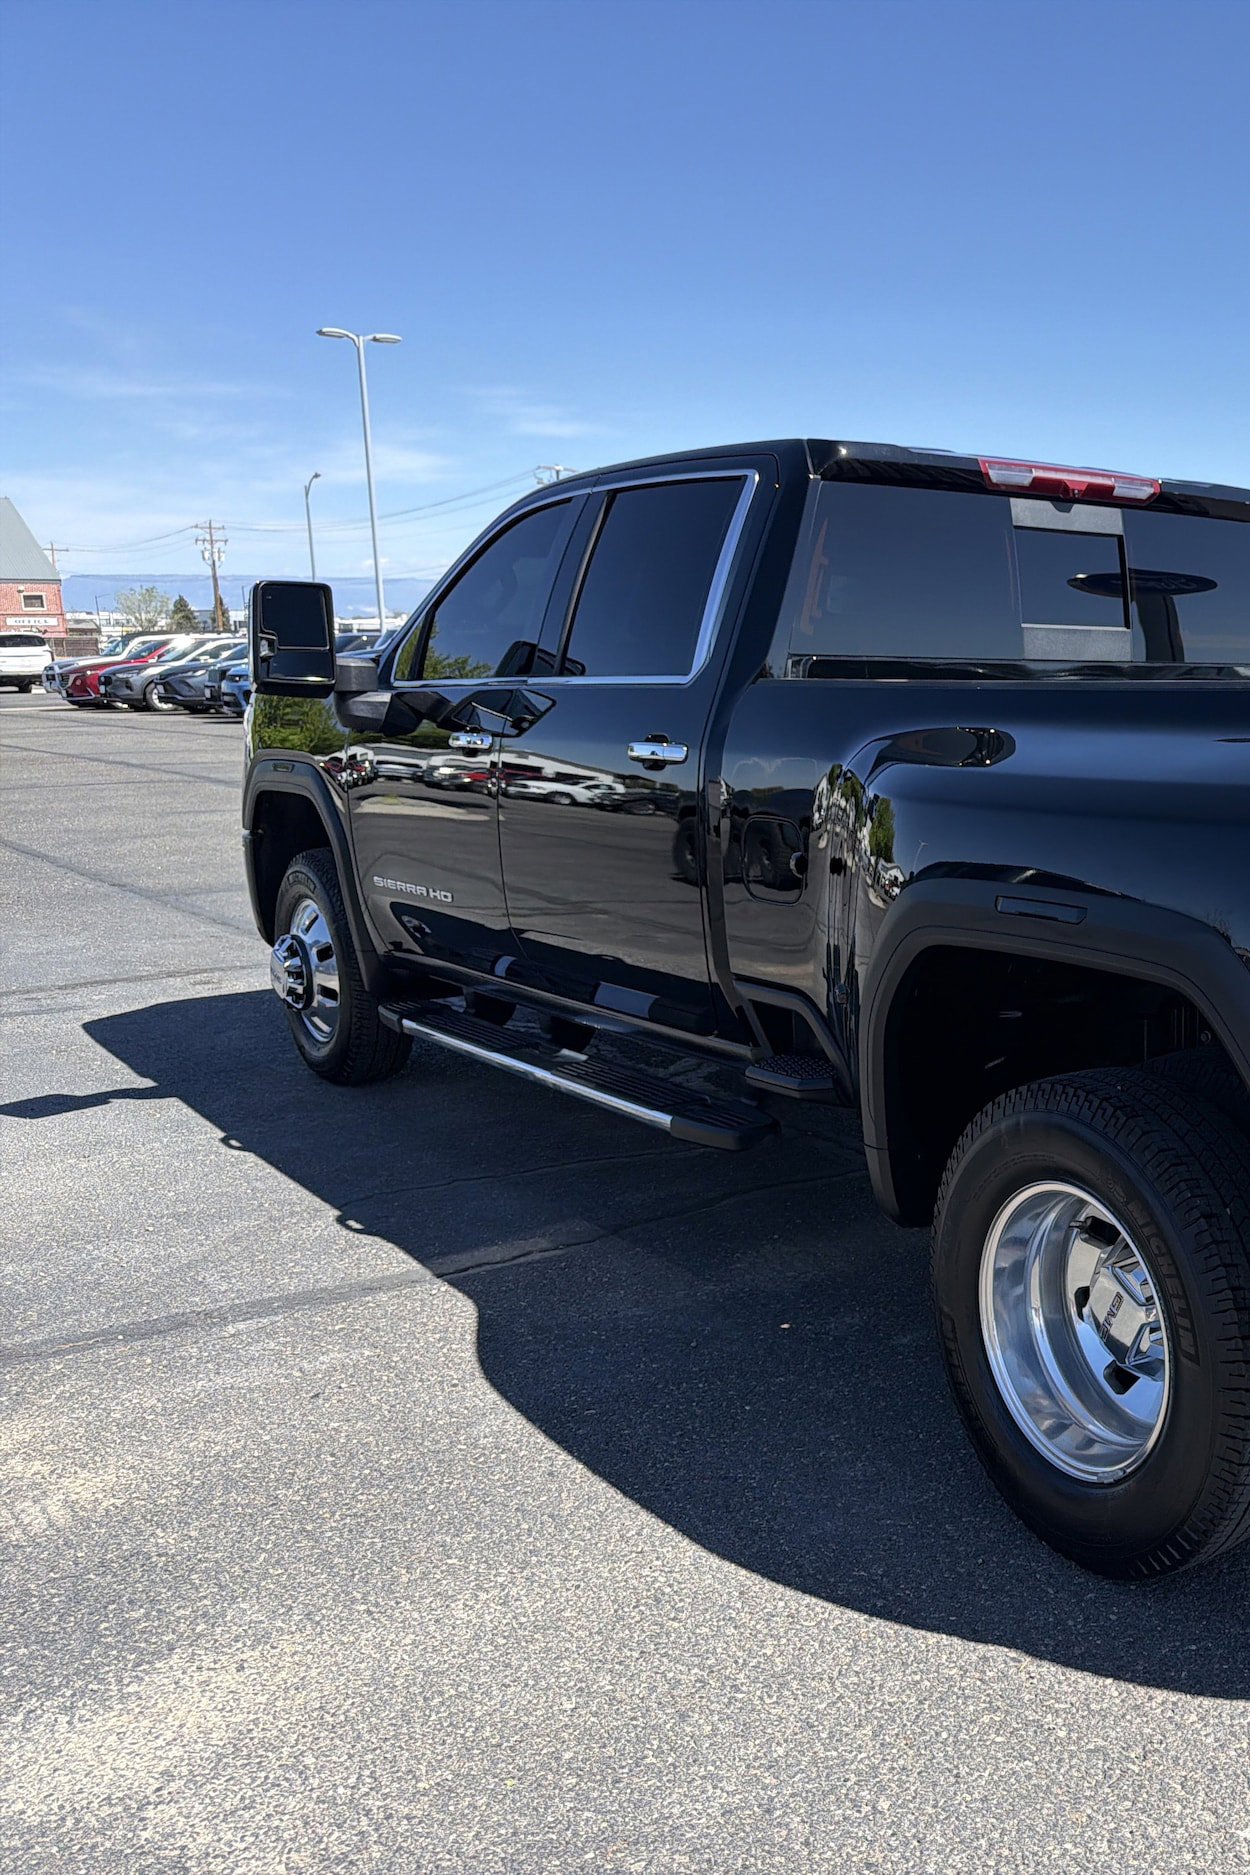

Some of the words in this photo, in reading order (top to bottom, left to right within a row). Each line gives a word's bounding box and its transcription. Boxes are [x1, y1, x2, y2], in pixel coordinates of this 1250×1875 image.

[373, 876, 427, 896] SIERRA
[429, 888, 453, 902] HD
[1100, 1291, 1124, 1342] GMC
